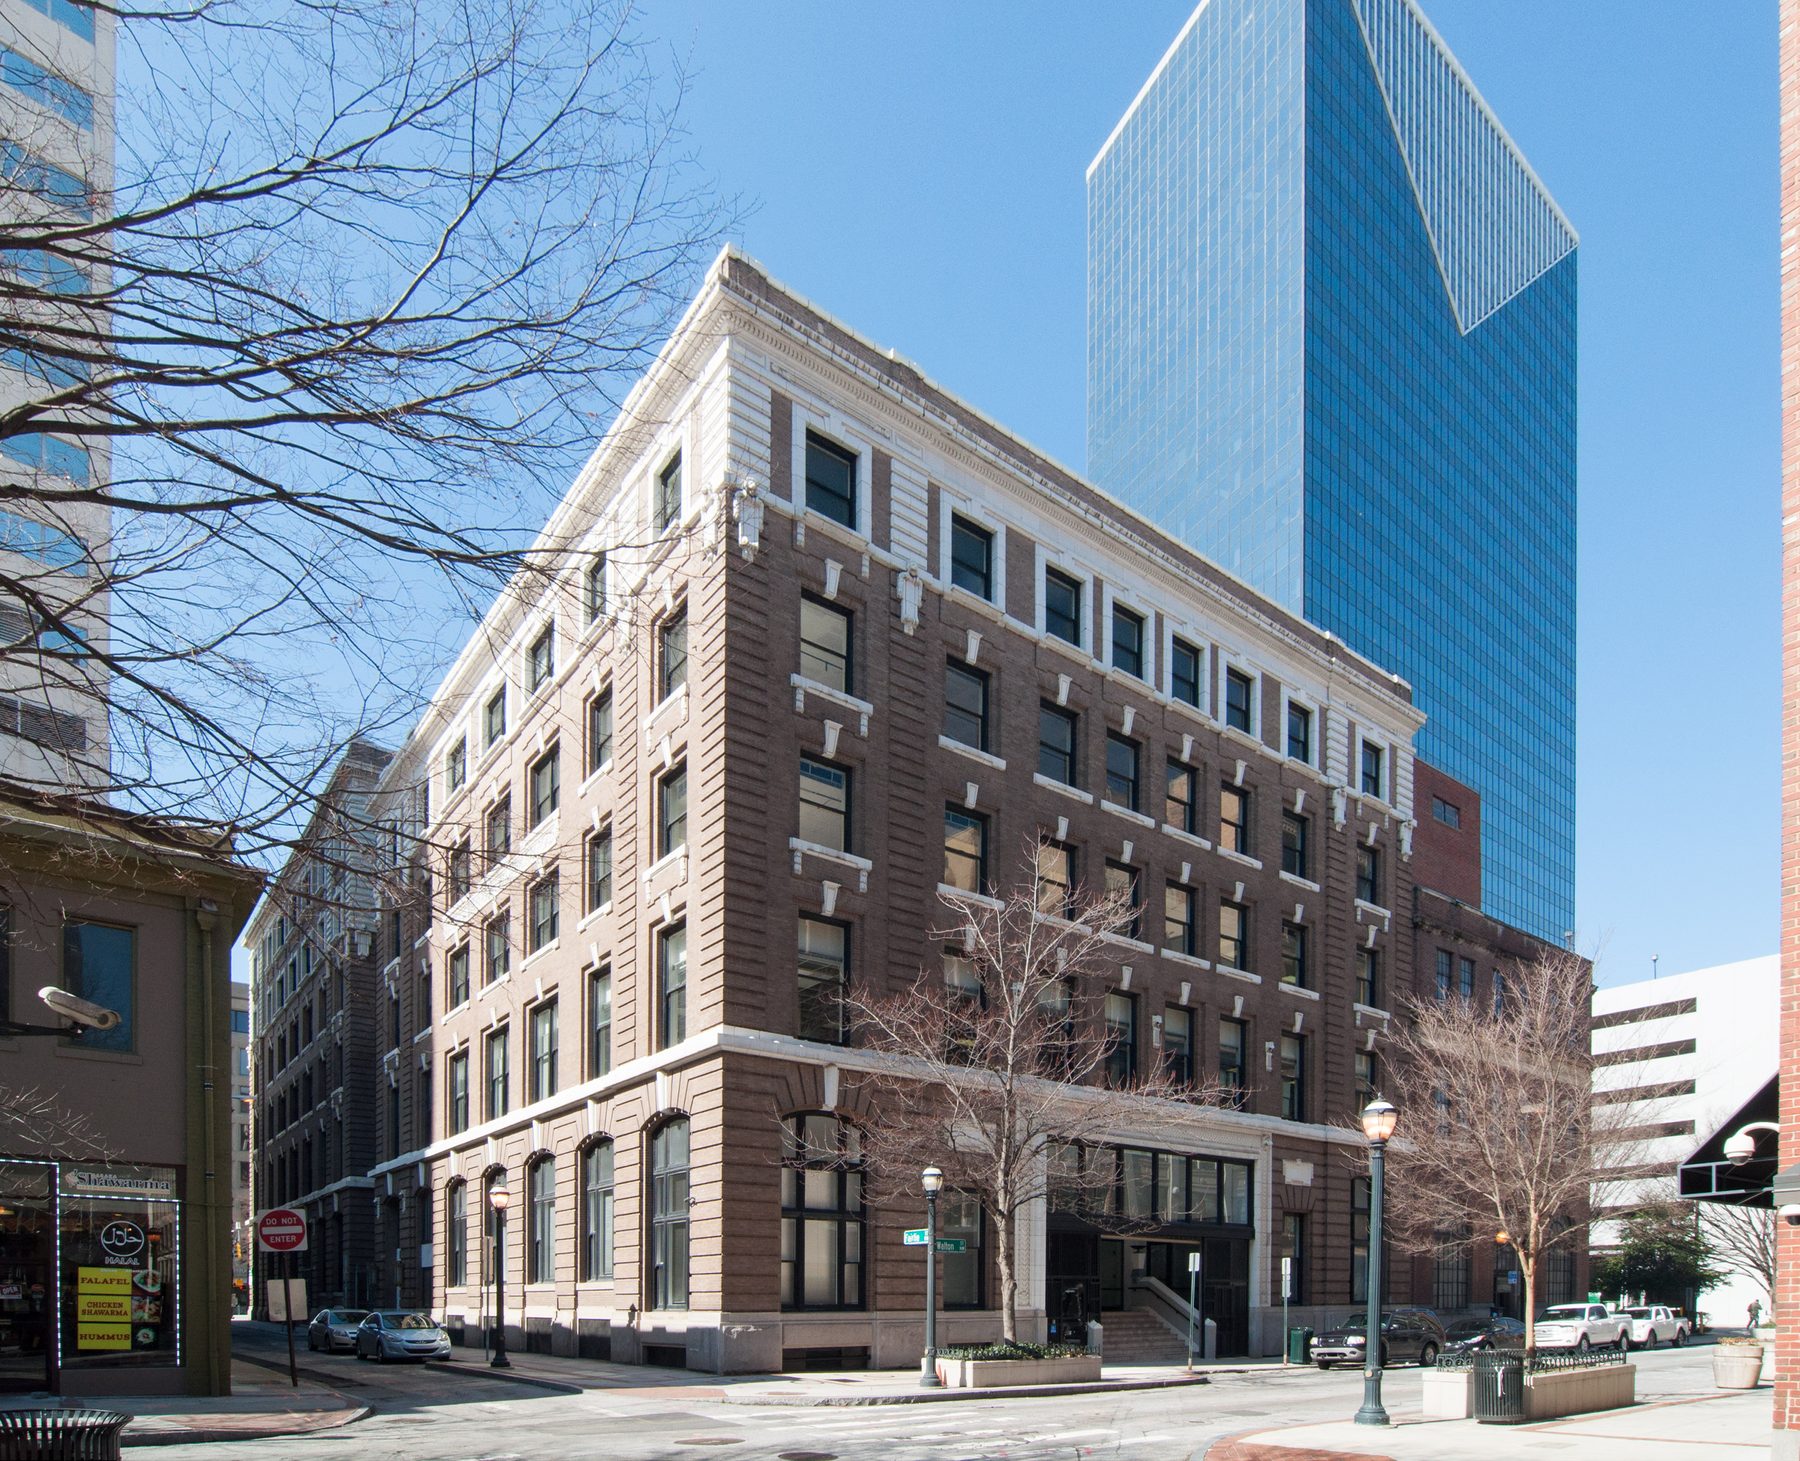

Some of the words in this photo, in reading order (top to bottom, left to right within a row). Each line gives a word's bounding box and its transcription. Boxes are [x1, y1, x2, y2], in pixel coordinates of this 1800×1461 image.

[77, 1171, 170, 1190] Shawarma
[281, 1217, 298, 1225] NOT
[103, 1228, 142, 1246] حلال
[270, 1235, 297, 1243] ENTER
[105, 1256, 140, 1265] HALAL
[80, 1277, 130, 1285] FALAFEL
[87, 1301, 124, 1309] CHICKEN
[81, 1308, 129, 1317] SHAWARMA
[80, 1333, 130, 1341] HUMMUS
